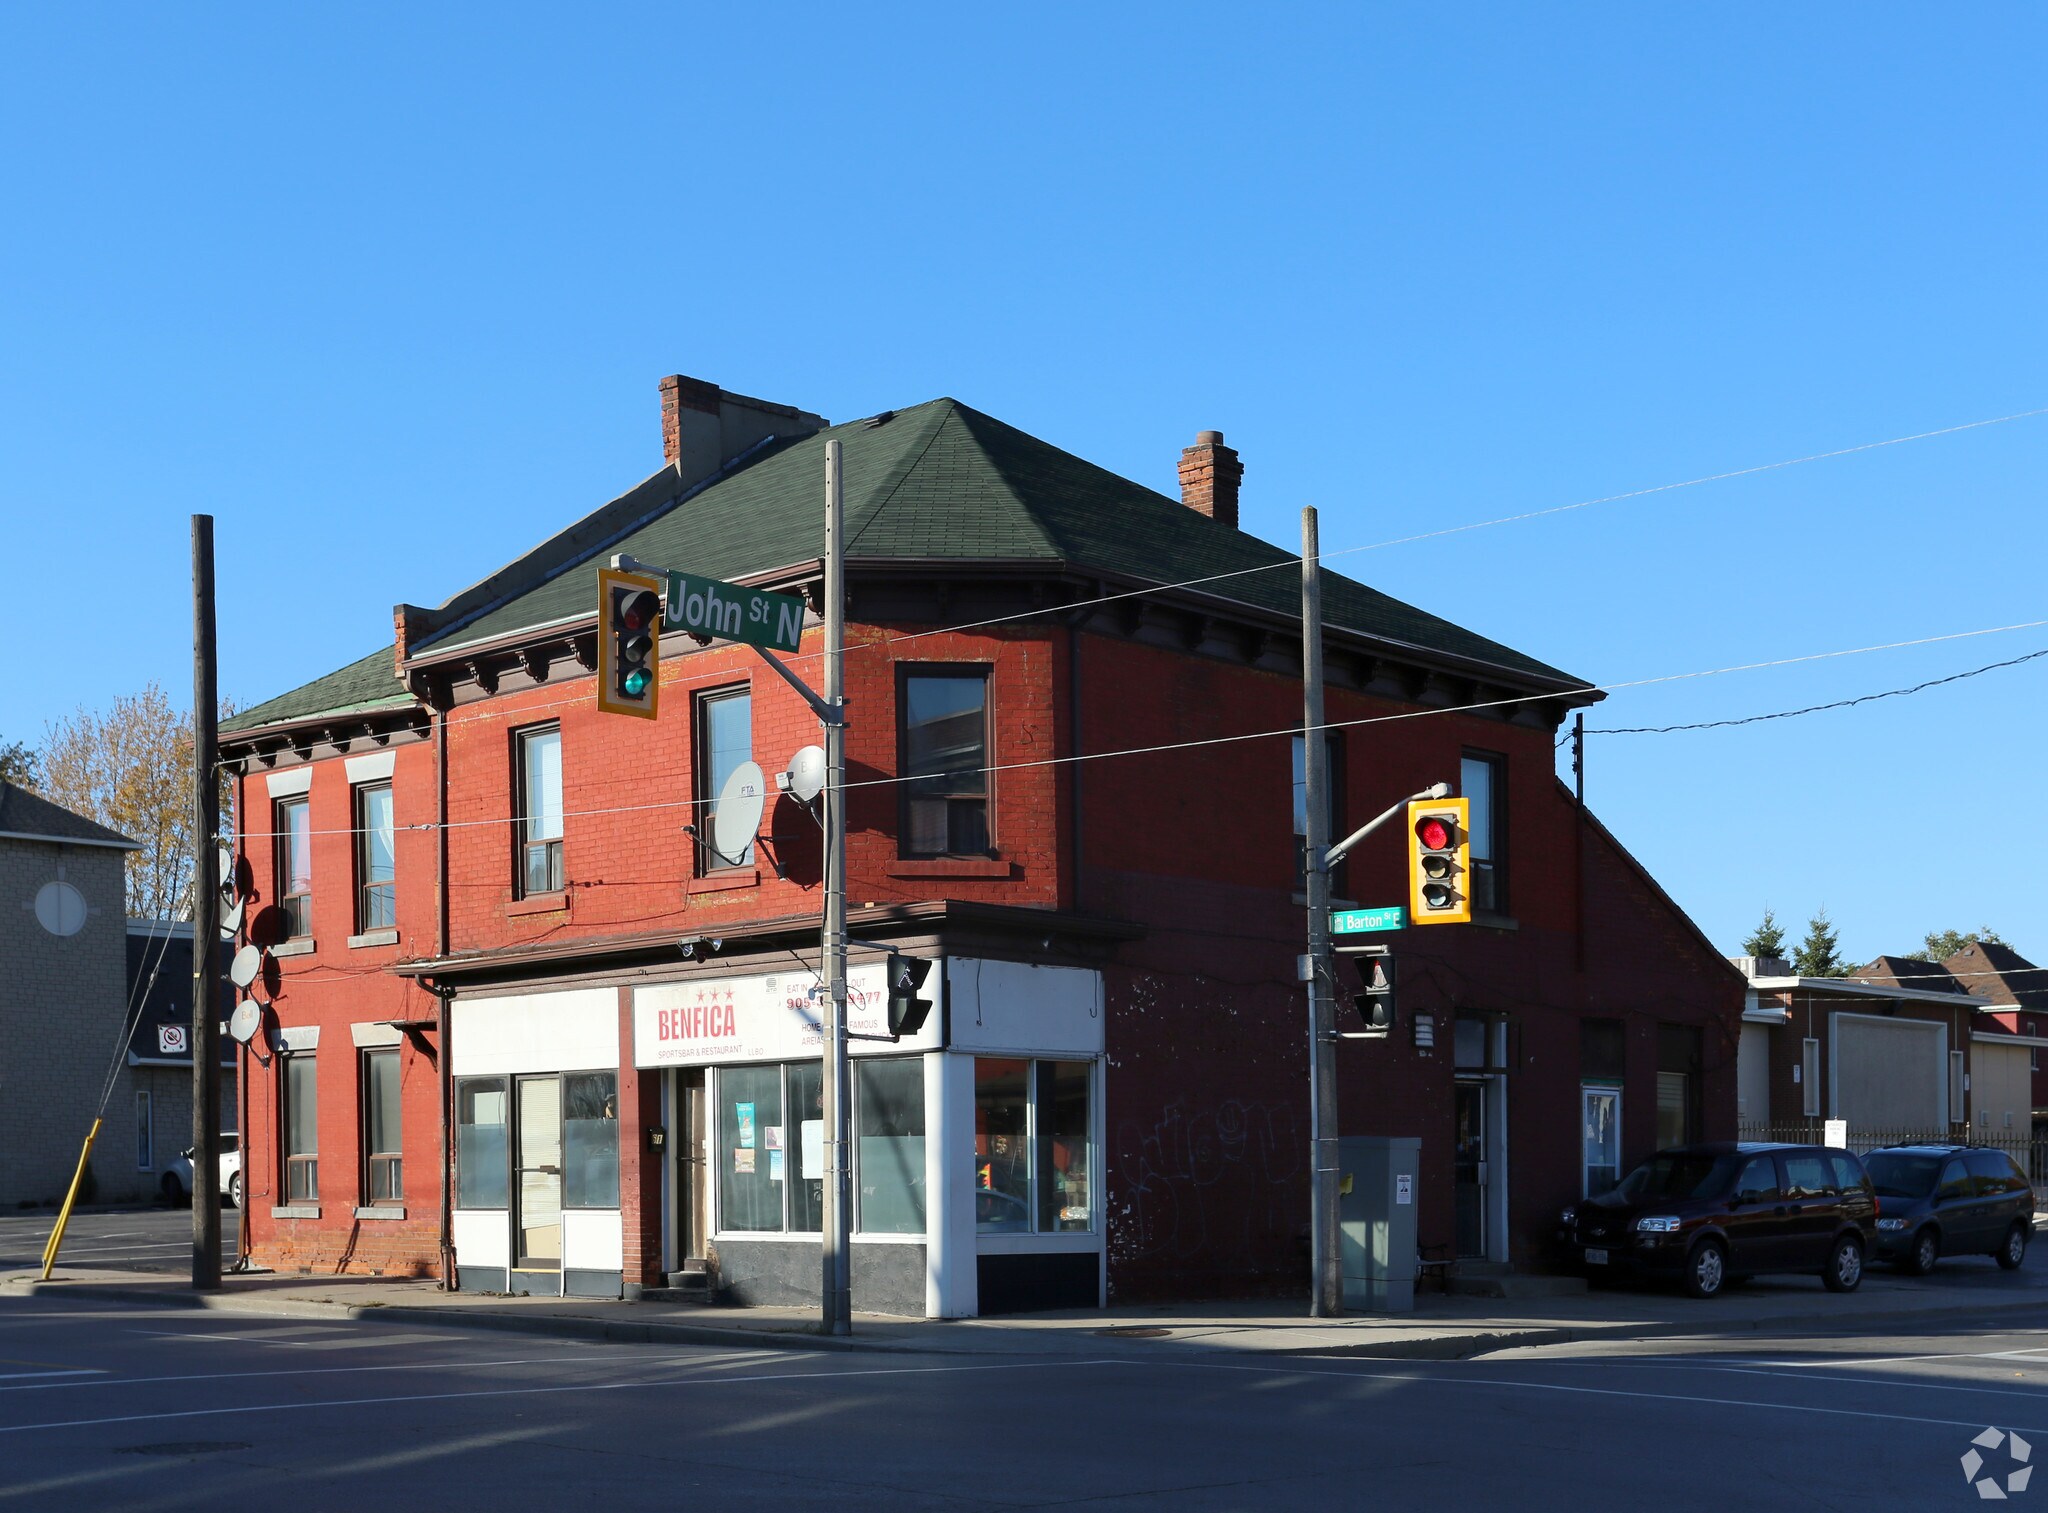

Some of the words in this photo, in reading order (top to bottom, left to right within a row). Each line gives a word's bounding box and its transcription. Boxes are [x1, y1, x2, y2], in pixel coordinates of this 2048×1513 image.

[668, 580, 742, 635] John
[749, 596, 770, 624] St
[776, 602, 802, 647] N
[1347, 915, 1383, 930] Barton
[1383, 912, 1391, 920] St
[1393, 912, 1400, 927] E
[787, 983, 799, 993] EAT
[801, 983, 808, 992] IN
[658, 1004, 736, 1041] BENFICA
[802, 1022, 821, 1032] HOME
[849, 1019, 878, 1029] FAMOUS
[658, 1048, 695, 1059] SPORTSBAR
[696, 1048, 701, 1056] &
[702, 1045, 743, 1056] RESTAURANT
